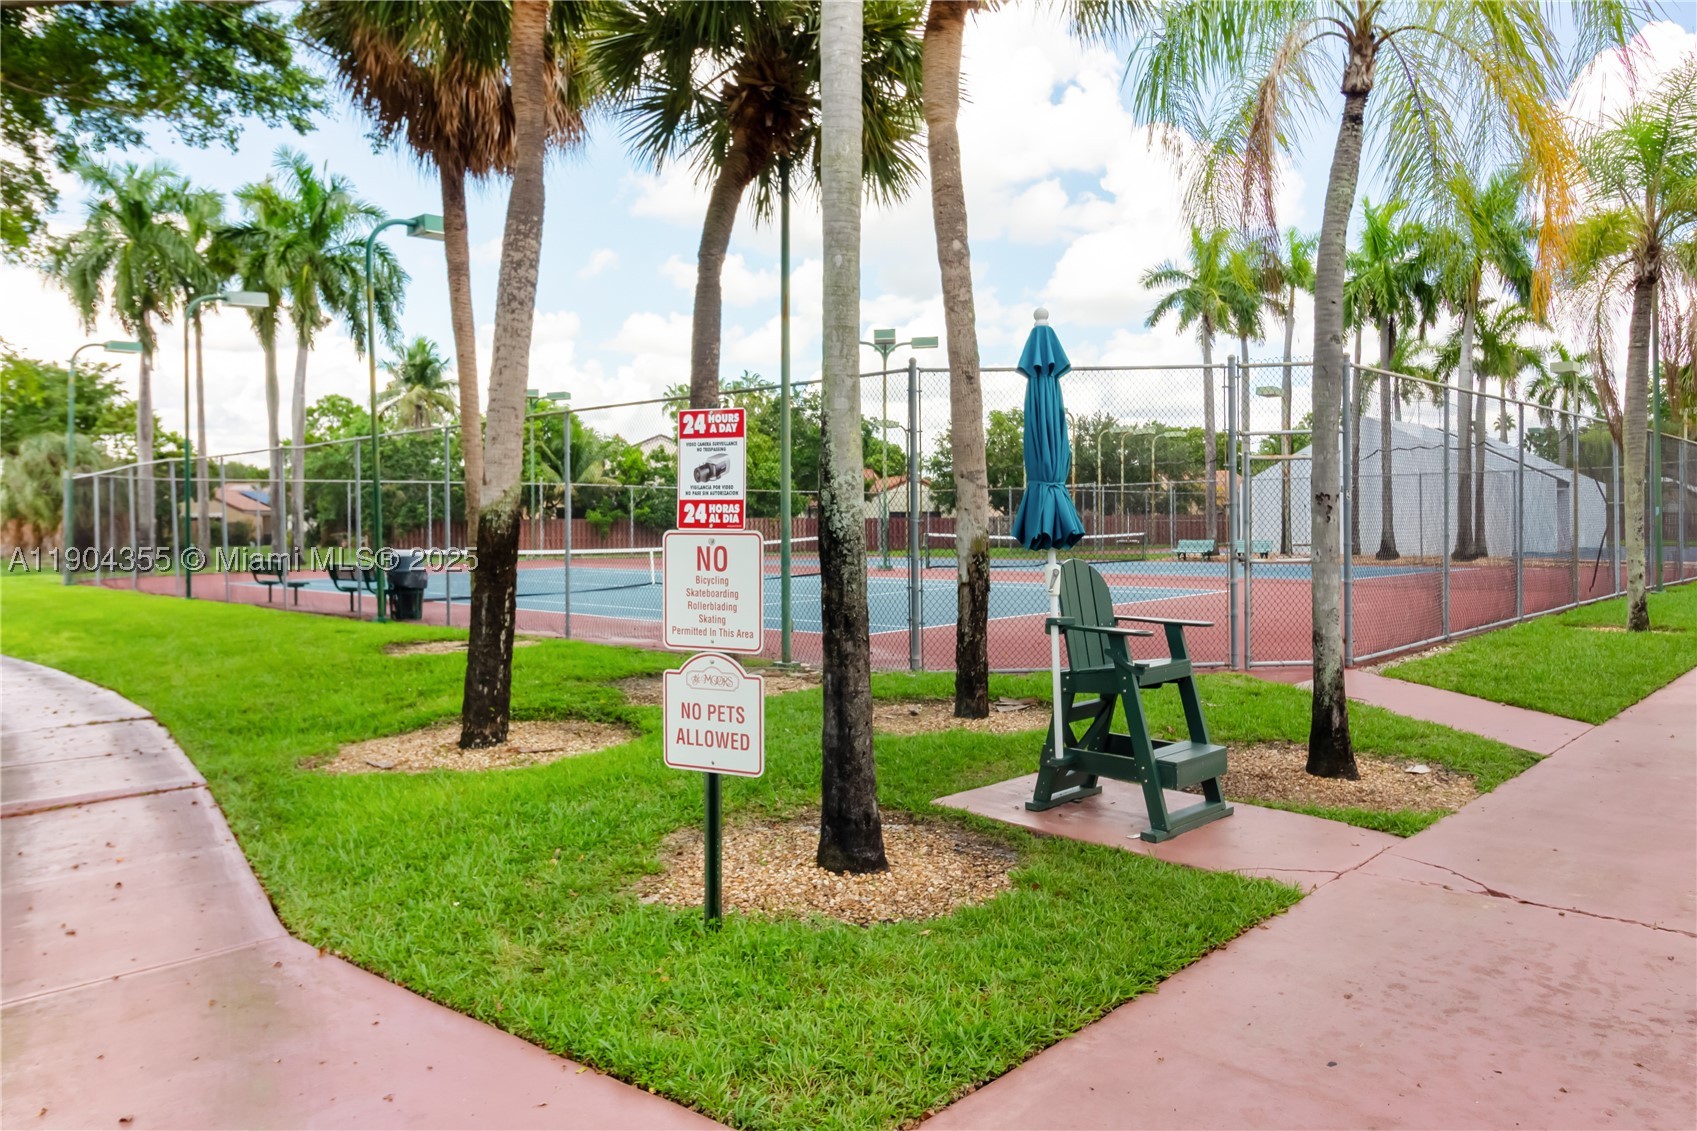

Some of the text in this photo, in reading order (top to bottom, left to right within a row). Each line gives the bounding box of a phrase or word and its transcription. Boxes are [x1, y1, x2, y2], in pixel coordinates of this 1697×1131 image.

[683, 413, 739, 434] 24 HOURS
[709, 423, 737, 433] A DAY
[683, 503, 740, 523] 24 HORAS
[709, 514, 739, 523] AL DIA
[697, 545, 727, 572] NO
[695, 575, 729, 587] Bicycling
[686, 587, 739, 600] Skateboarding
[687, 601, 737, 613] Rollerblading
[698, 614, 726, 626] Skating
[672, 626, 754, 639] Permitted In This Area
[681, 702, 745, 724] NO PETS
[676, 727, 750, 751] ALLOWED
